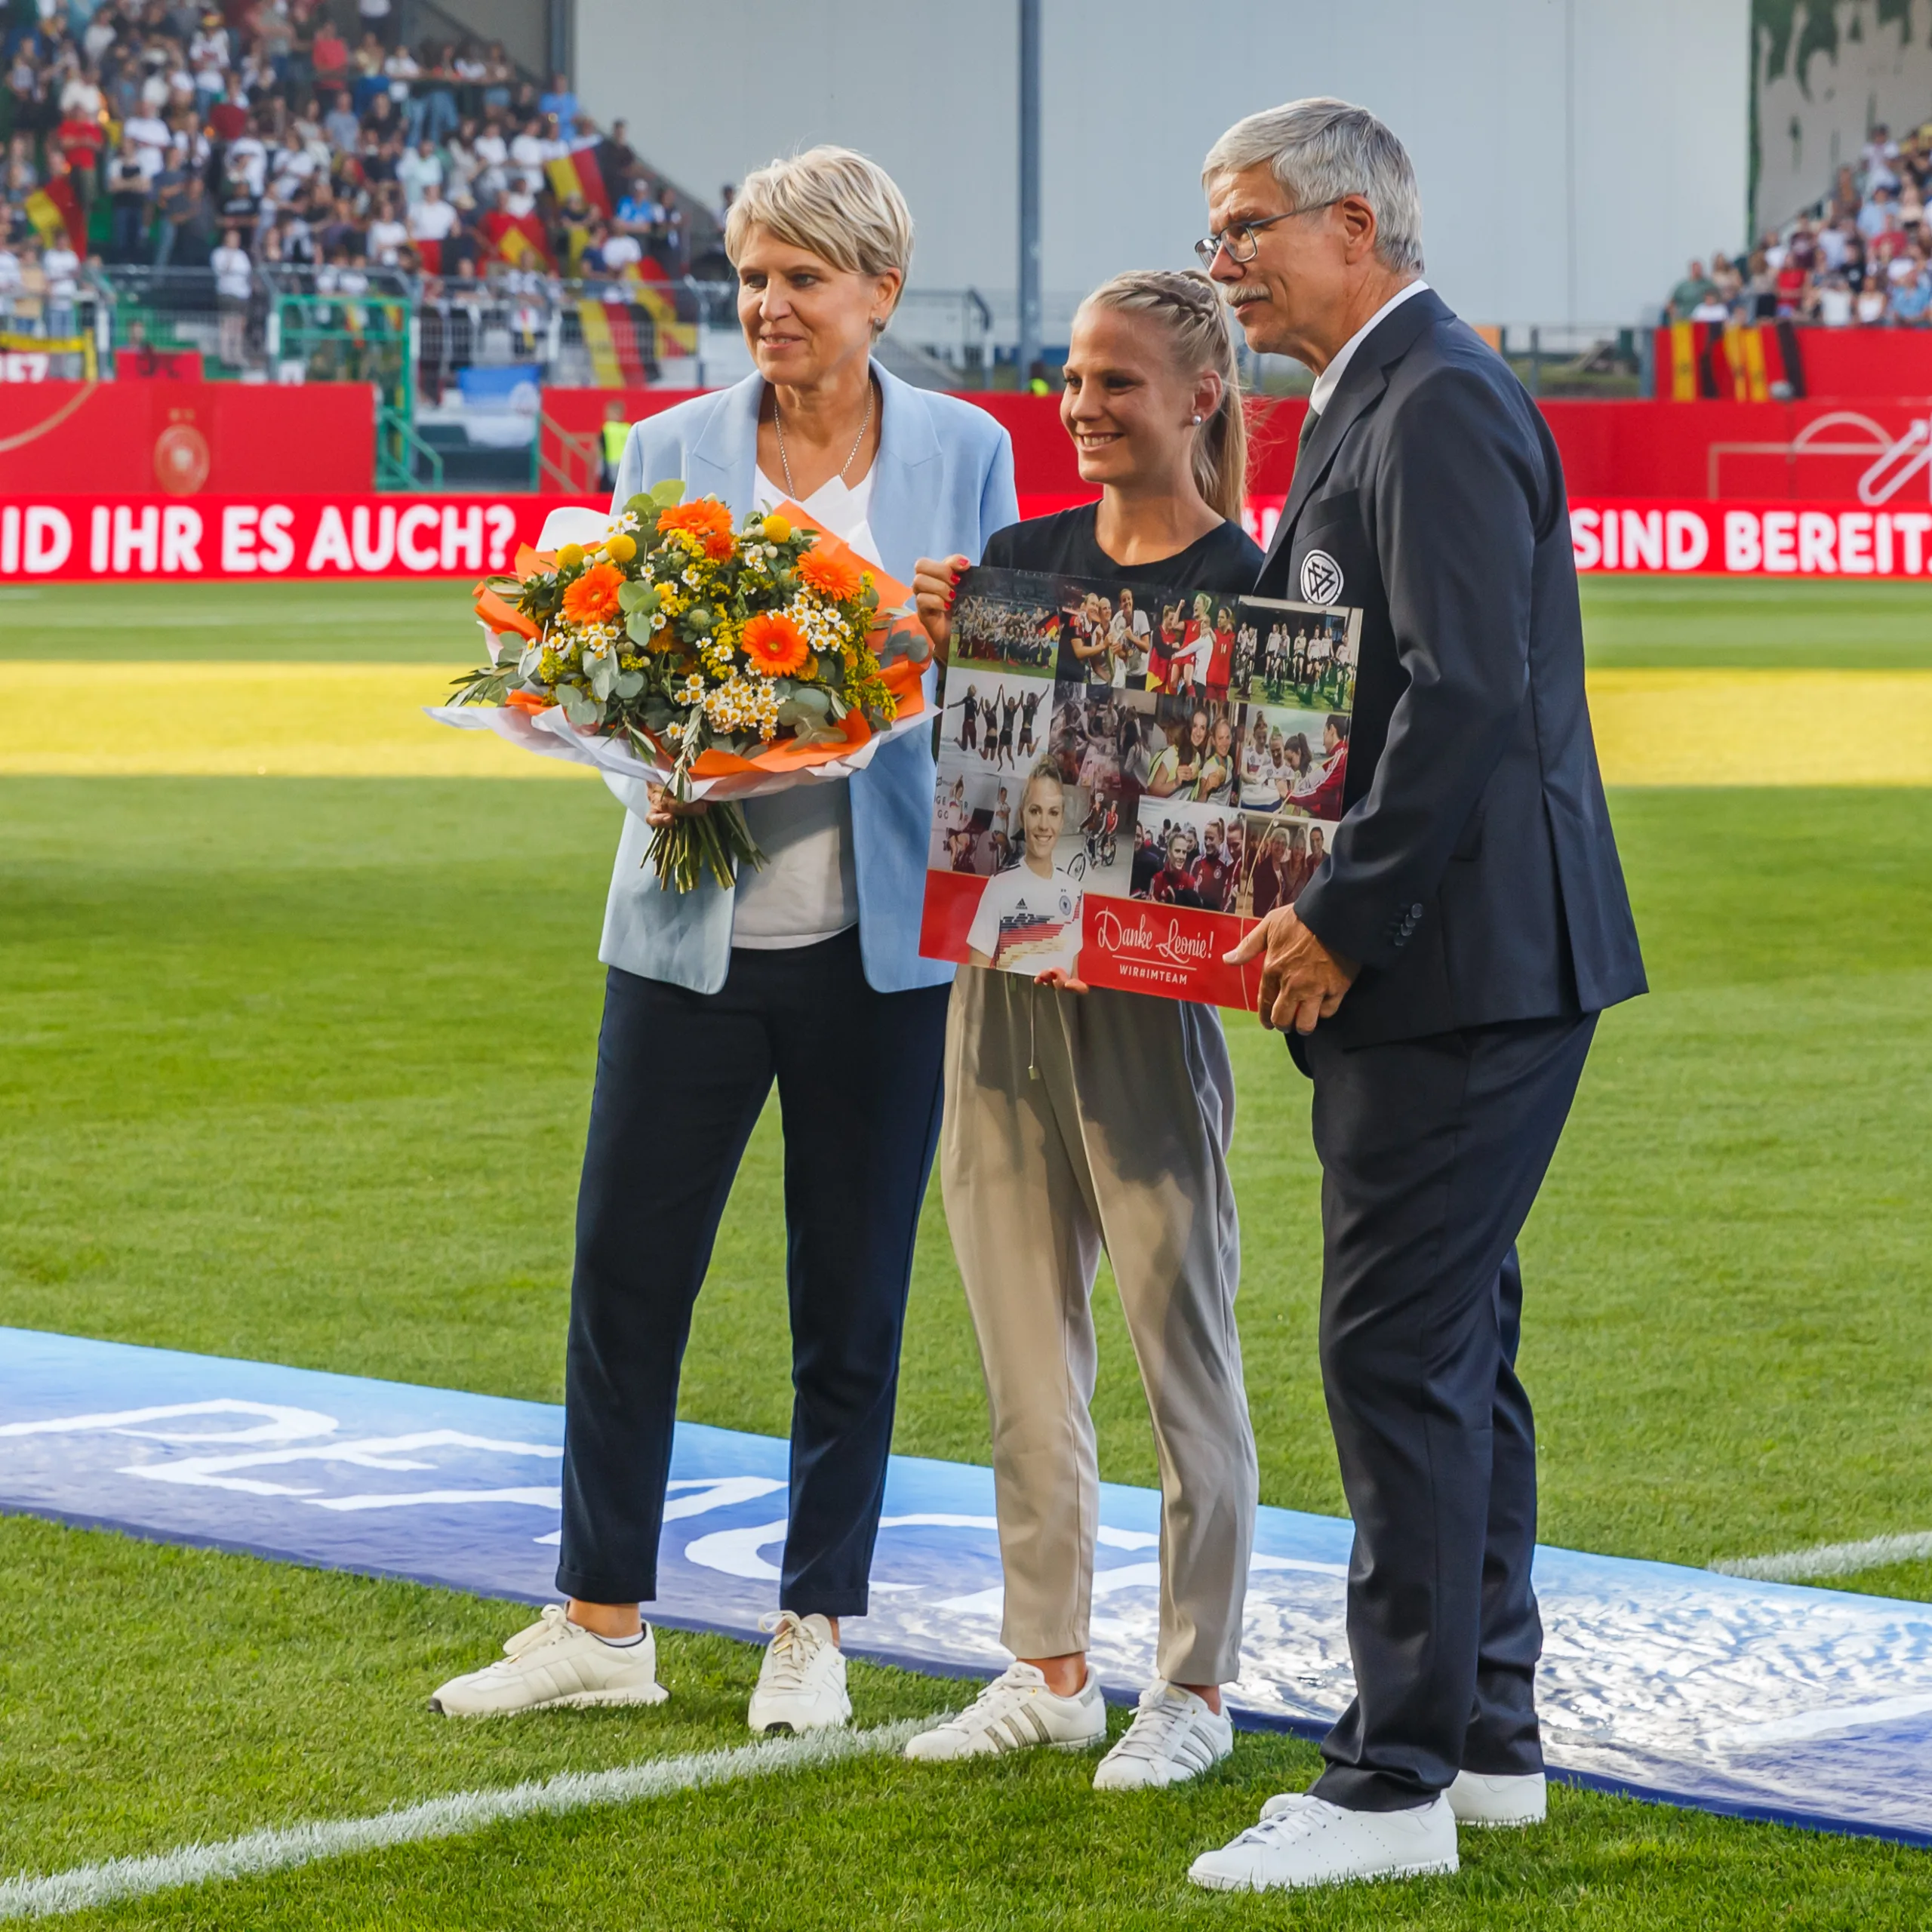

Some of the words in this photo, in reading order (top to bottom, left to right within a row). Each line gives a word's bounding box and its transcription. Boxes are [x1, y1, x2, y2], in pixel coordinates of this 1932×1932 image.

[91, 506, 202, 572] IHR
[222, 505, 294, 571] ES
[307, 505, 515, 571] AUCH?
[1569, 509, 1708, 569] SIND
[1094, 906, 1152, 951] Danke
[1155, 918, 1214, 964] Leonie!
[1118, 964, 1188, 985] WIR#IMTEAM
